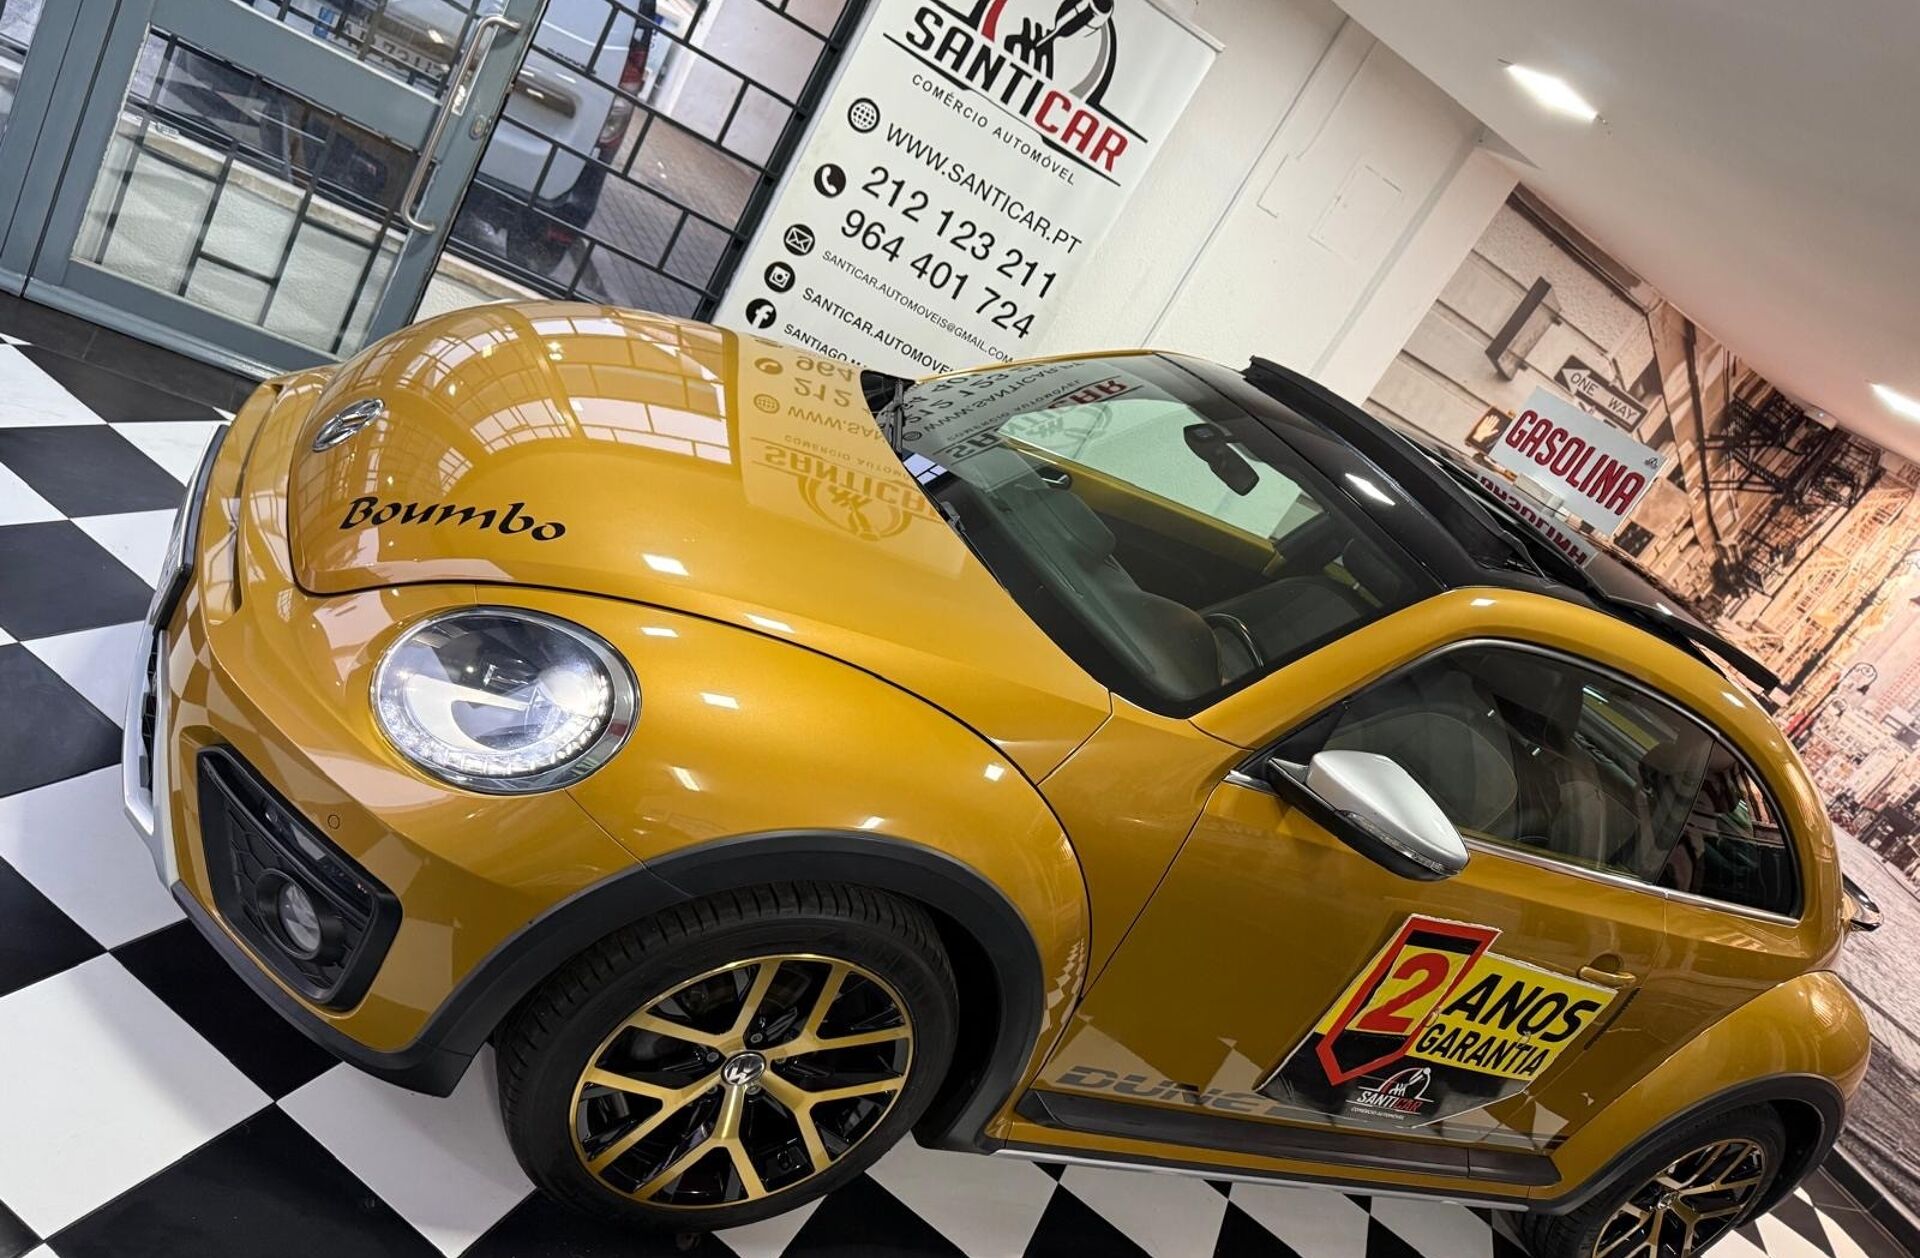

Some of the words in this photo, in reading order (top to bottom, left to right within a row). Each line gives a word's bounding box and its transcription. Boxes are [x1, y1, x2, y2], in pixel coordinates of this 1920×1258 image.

[905, 6, 1128, 172] SANTICAR
[912, 74, 989, 128] COMÉRCIO
[992, 127, 1075, 185] AUTOMÓVEL
[861, 166, 929, 222] 212
[936, 210, 995, 261] 123
[996, 249, 1057, 298] 211
[886, 122, 1083, 254] WWW.SANTICAR.PT
[822, 250, 1014, 364] SANTICAR.AUTOMOVEIS@GMAIL.COM
[841, 209, 905, 262] 964
[910, 253, 969, 300] 401
[975, 286, 1036, 339] 724
[802, 287, 954, 374] SANTICAR.AUTOMOVE
[1570, 372, 1599, 397] ONE
[1607, 397, 1638, 425] WAY
[1505, 409, 1646, 516] GASOLINA
[338, 496, 567, 541] Boumbo
[1356, 952, 1451, 1032] 2
[1442, 973, 1603, 1043] ANOS
[1055, 1065, 1266, 1112] DUNE
[1415, 1023, 1551, 1078] GARANTIA
[1356, 1090, 1424, 1113] SANTICAR
